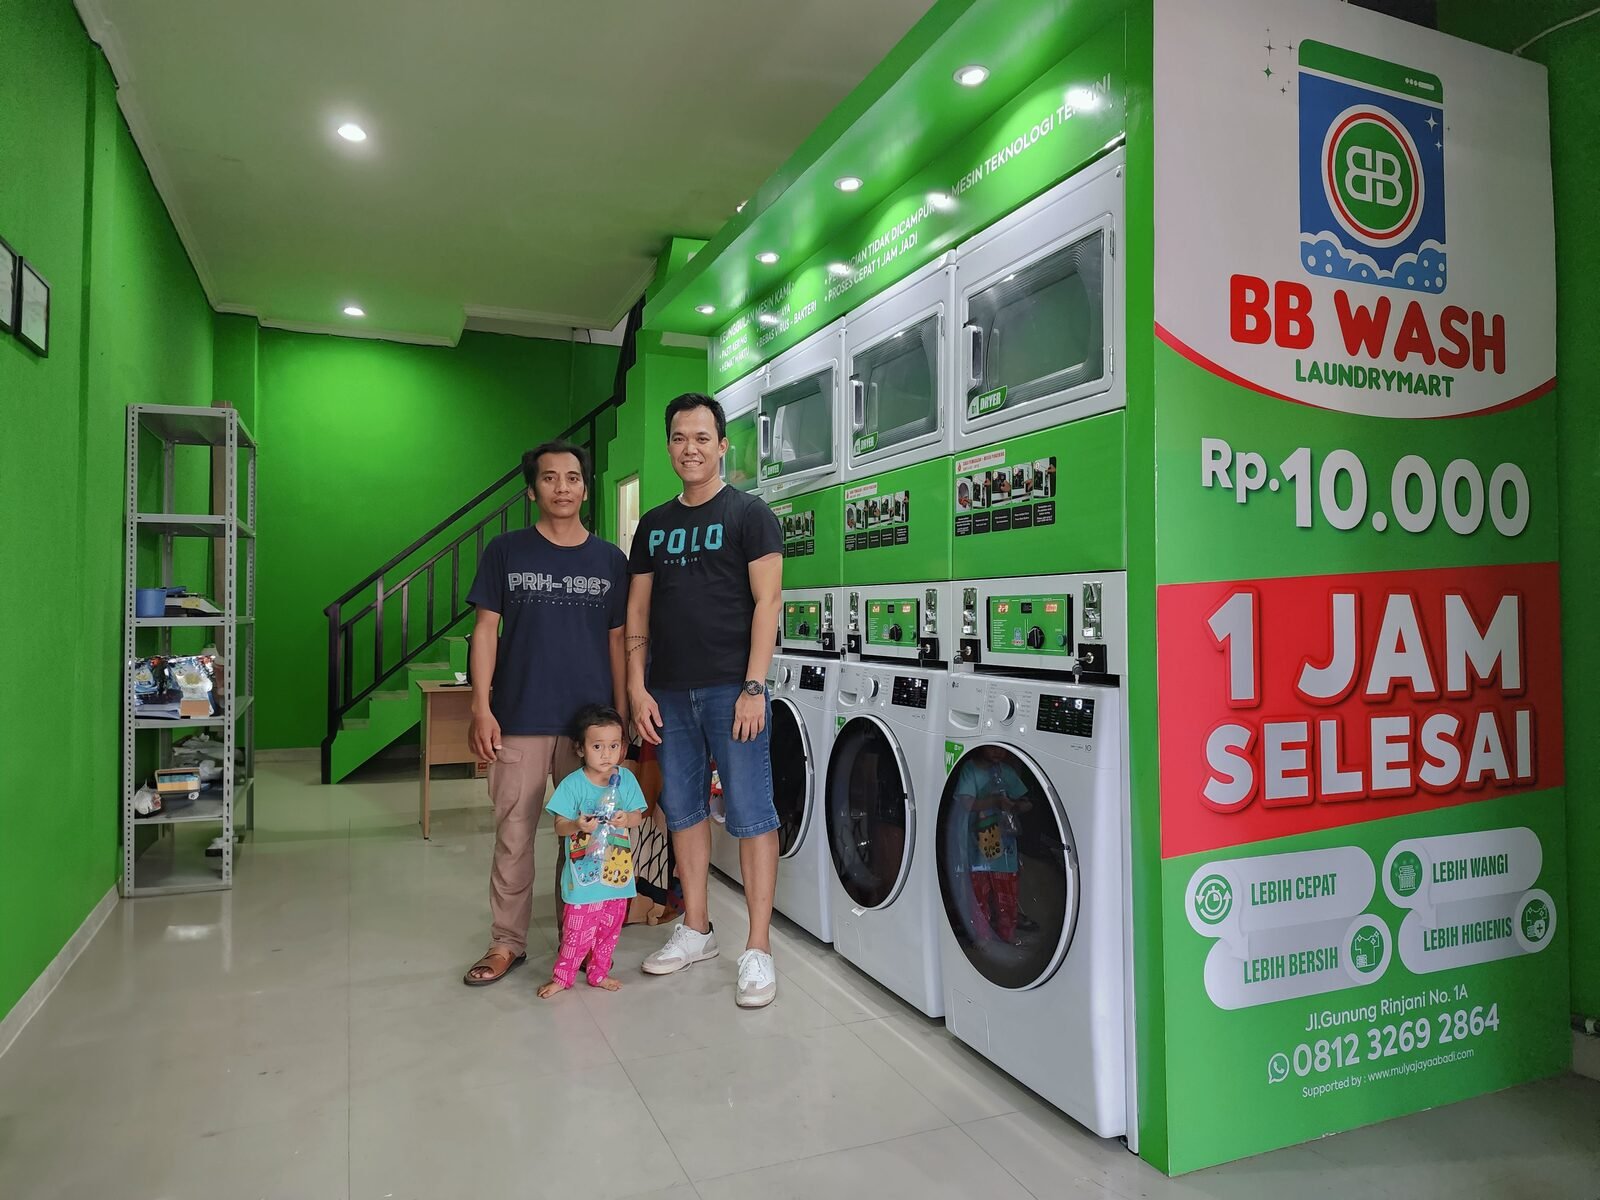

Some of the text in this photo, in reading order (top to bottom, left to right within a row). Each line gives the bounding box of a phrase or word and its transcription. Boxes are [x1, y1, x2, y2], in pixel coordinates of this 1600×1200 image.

[951, 165, 983, 196] MESIN
[985, 114, 1054, 174] TEKNOLOGI
[867, 231, 891, 254] TIDAK
[828, 279, 853, 301] PROSES
[854, 260, 876, 283] CEPAT
[881, 245, 898, 266] JAM
[899, 231, 918, 255] JADI
[793, 299, 817, 325] BAKTERI
[1229, 274, 1506, 375] BB WASH
[1295, 359, 1454, 398] LAUNDRYMART
[979, 391, 1001, 410] DRYER
[648, 523, 724, 557] POLO
[1207, 593, 1521, 700] 1 JAM
[1202, 709, 1531, 806] SELESAI
[1432, 853, 1509, 884] LEBIH WANGI
[1250, 872, 1338, 906] LEBIH CEPAT
[1423, 916, 1513, 952] LEBIH HIGIENIS
[1243, 946, 1339, 985] LEBIH BERSIH
[1380, 991, 1427, 1018] Rinjani
[1429, 987, 1451, 1004] No.
[1453, 983, 1469, 1001] 1A
[1292, 1002, 1500, 1077] 0812 3269 2864
[1302, 1076, 1350, 1098] Supported
[1351, 1074, 1363, 1089] by
[1367, 1047, 1475, 1083] www.mulyajayaabadi.com
